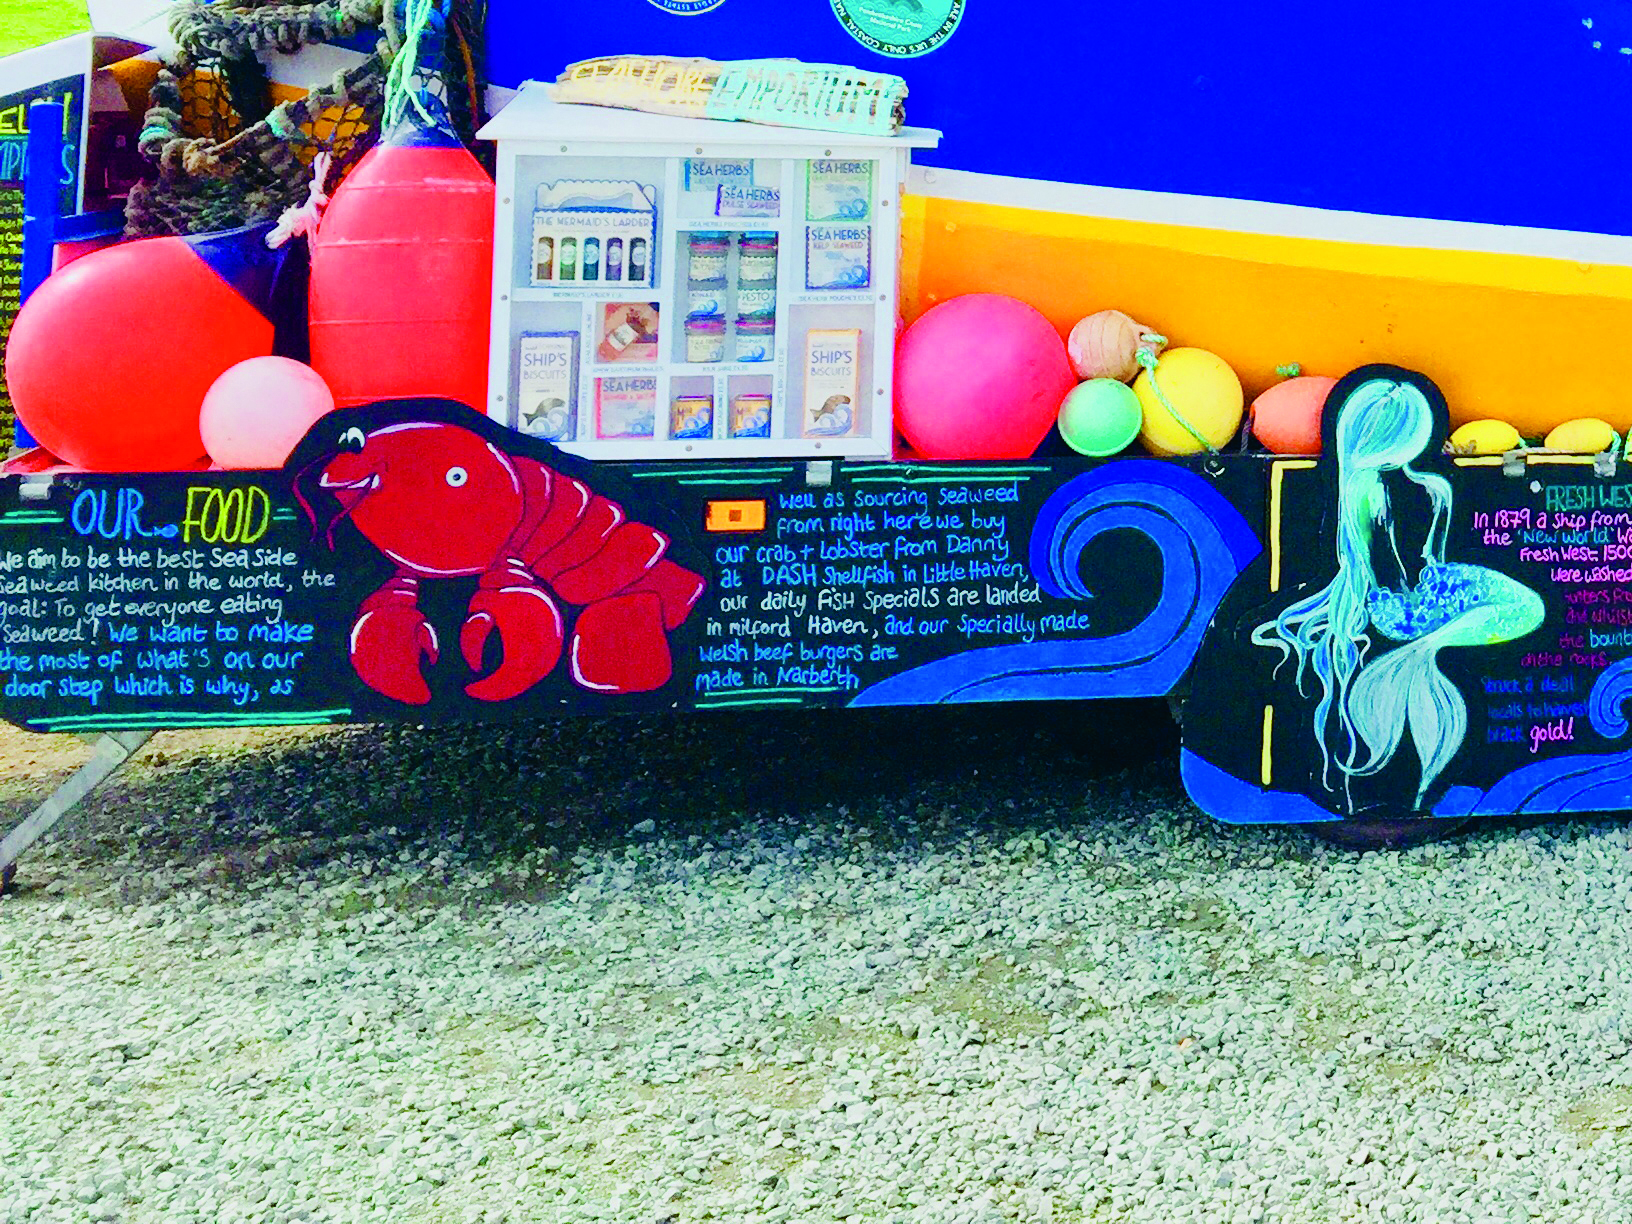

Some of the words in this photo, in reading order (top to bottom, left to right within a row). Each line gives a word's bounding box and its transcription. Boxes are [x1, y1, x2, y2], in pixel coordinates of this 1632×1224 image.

[692, 161, 714, 175] SEA
[715, 161, 749, 175] HERBS
[812, 160, 833, 174] SEA
[834, 161, 868, 174] HERBS
[724, 187, 745, 200] SEA
[746, 188, 780, 201] HERBS
[535, 216, 553, 226] THE
[613, 217, 649, 227] LARDER
[811, 228, 833, 241] SEA
[834, 227, 867, 241] HERBS
[524, 352, 567, 367] SHIP'S
[811, 350, 852, 364] SHIP'S
[524, 370, 566, 380] BISCUITS
[810, 367, 851, 376] BISCUITS
[70, 487, 153, 540] OUR
[182, 486, 271, 543] FOOD
[1474, 512, 1489, 529] In
[1495, 508, 1531, 529] 1879
[1552, 510, 1586, 531] ship
[1591, 511, 1632, 529] from
[61, 550, 81, 569] to
[87, 545, 111, 569] be
[116, 548, 152, 569] the
[156, 546, 204, 569] best
[720, 595, 748, 612] our
[761, 590, 807, 617] daily
[947, 587, 980, 607] are
[986, 581, 1042, 606] landed
[5, 678, 53, 697] door
[58, 678, 103, 706] step
[114, 674, 173, 696] which
[179, 674, 195, 695] is
[269, 679, 295, 697] as
[1530, 718, 1574, 753] gold!
